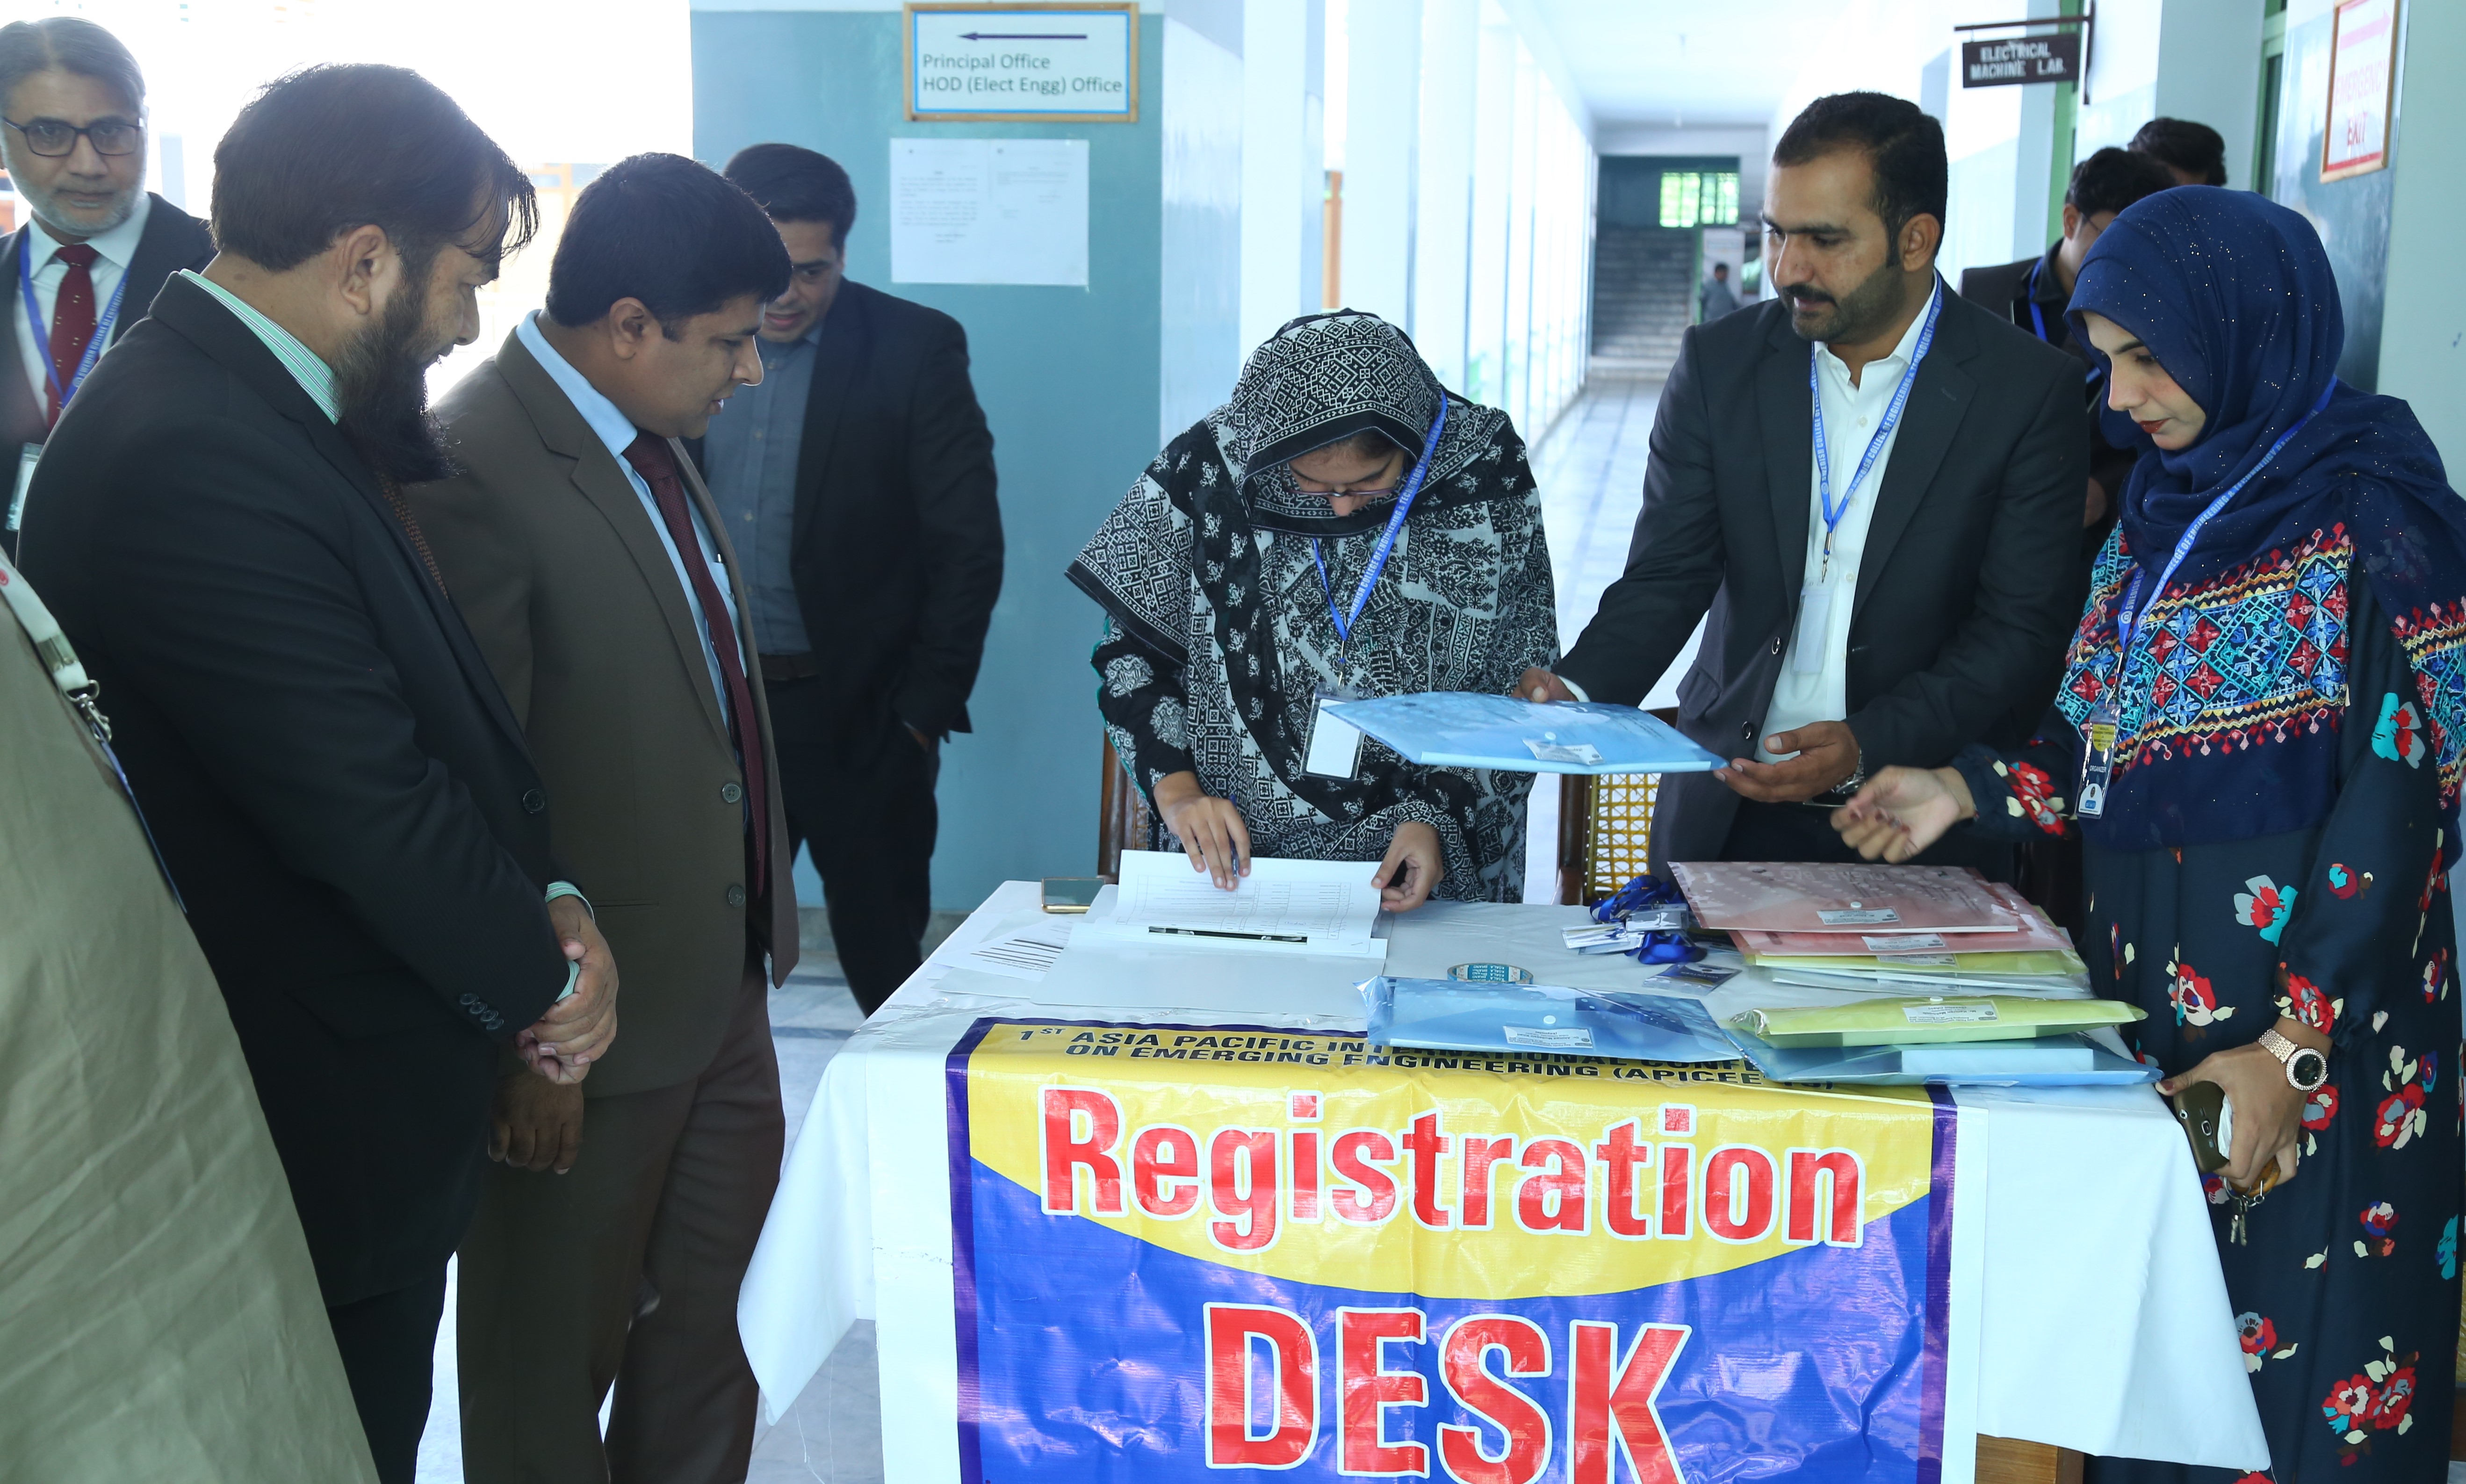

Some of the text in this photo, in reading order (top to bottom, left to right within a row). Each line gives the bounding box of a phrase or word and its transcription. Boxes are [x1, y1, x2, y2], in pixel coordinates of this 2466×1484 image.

[923, 54, 1050, 71] Principal Office
[1981, 42, 2051, 62] ELECTRICAL
[923, 77, 1122, 94] HOD (Elect Engg) Office
[1969, 61, 2026, 80] MACHINE
[2335, 59, 2389, 106] EMERGENC
[2348, 112, 2368, 146] EXIT
[1852, 459, 1872, 488] SWEDISH
[1868, 430, 1888, 461] COLLEGE
[1882, 422, 1892, 433] OF
[1887, 377, 1911, 423] ENGINEERING
[1911, 327, 1933, 372] TECHNOLOGY
[1814, 418, 1824, 450] COLLEGE
[1817, 450, 1827, 481] SWEDISH
[1350, 587, 1365, 617] SWEDISH
[1361, 562, 1379, 588] COLLEGE
[1373, 551, 1383, 563] OF
[1378, 510, 1402, 553] ENGINEERING
[1400, 463, 1425, 504] TECHNOLOGY
[2164, 549, 2185, 580] COLLEGE
[2181, 538, 2192, 550] OF
[2188, 495, 2229, 539] ENGINEERING
[2126, 580, 2141, 610] SWEDISH
[1071, 1032, 1159, 1047] ASIA
[1174, 1035, 1312, 1052] PACIFIC
[1065, 1044, 1120, 1058] ON
[1130, 1046, 1330, 1066] EMERGING
[1343, 1054, 1600, 1076] ENGINEERING
[1039, 1086, 1866, 1253] Registration
[1204, 1301, 1694, 1484] DESK
